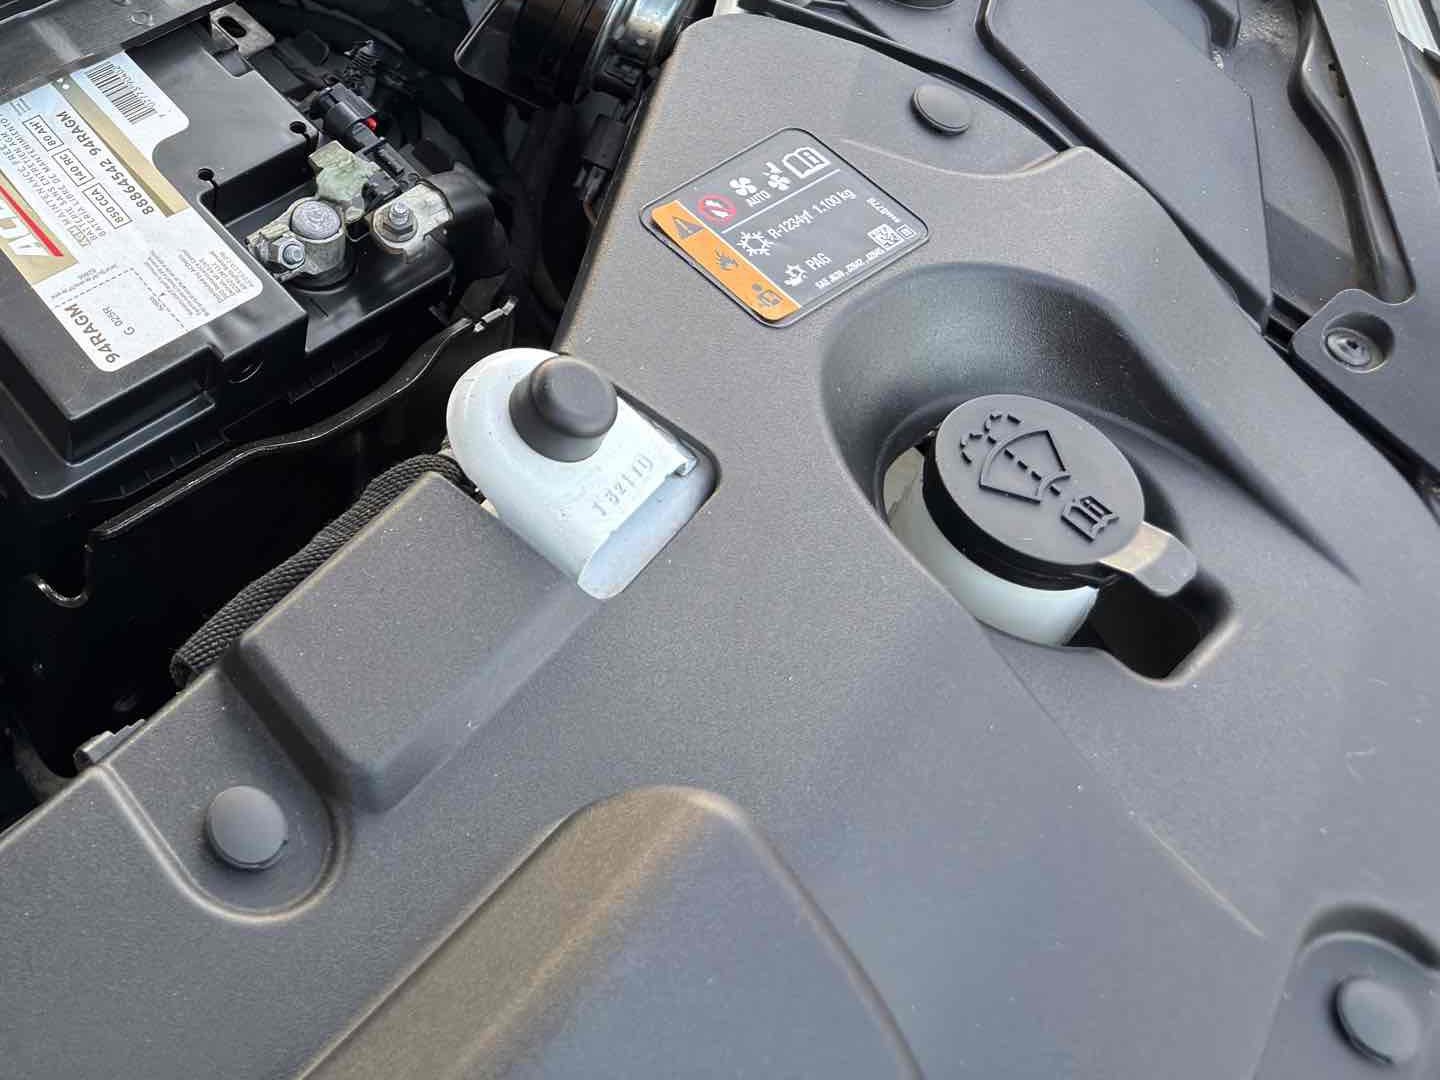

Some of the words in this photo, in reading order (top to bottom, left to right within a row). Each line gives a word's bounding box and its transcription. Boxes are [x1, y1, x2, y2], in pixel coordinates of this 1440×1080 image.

[41, 133, 57, 147] 80
[54, 109, 103, 156] 94RAGM
[57, 152, 74, 166] RC
[68, 164, 87, 181] 140
[98, 157, 155, 216] 88864542
[88, 187, 110, 207] CCA
[744, 189, 771, 208] AUTO
[103, 204, 124, 224] 850
[805, 251, 832, 272] PAG
[62, 301, 122, 364] 94RAGM
